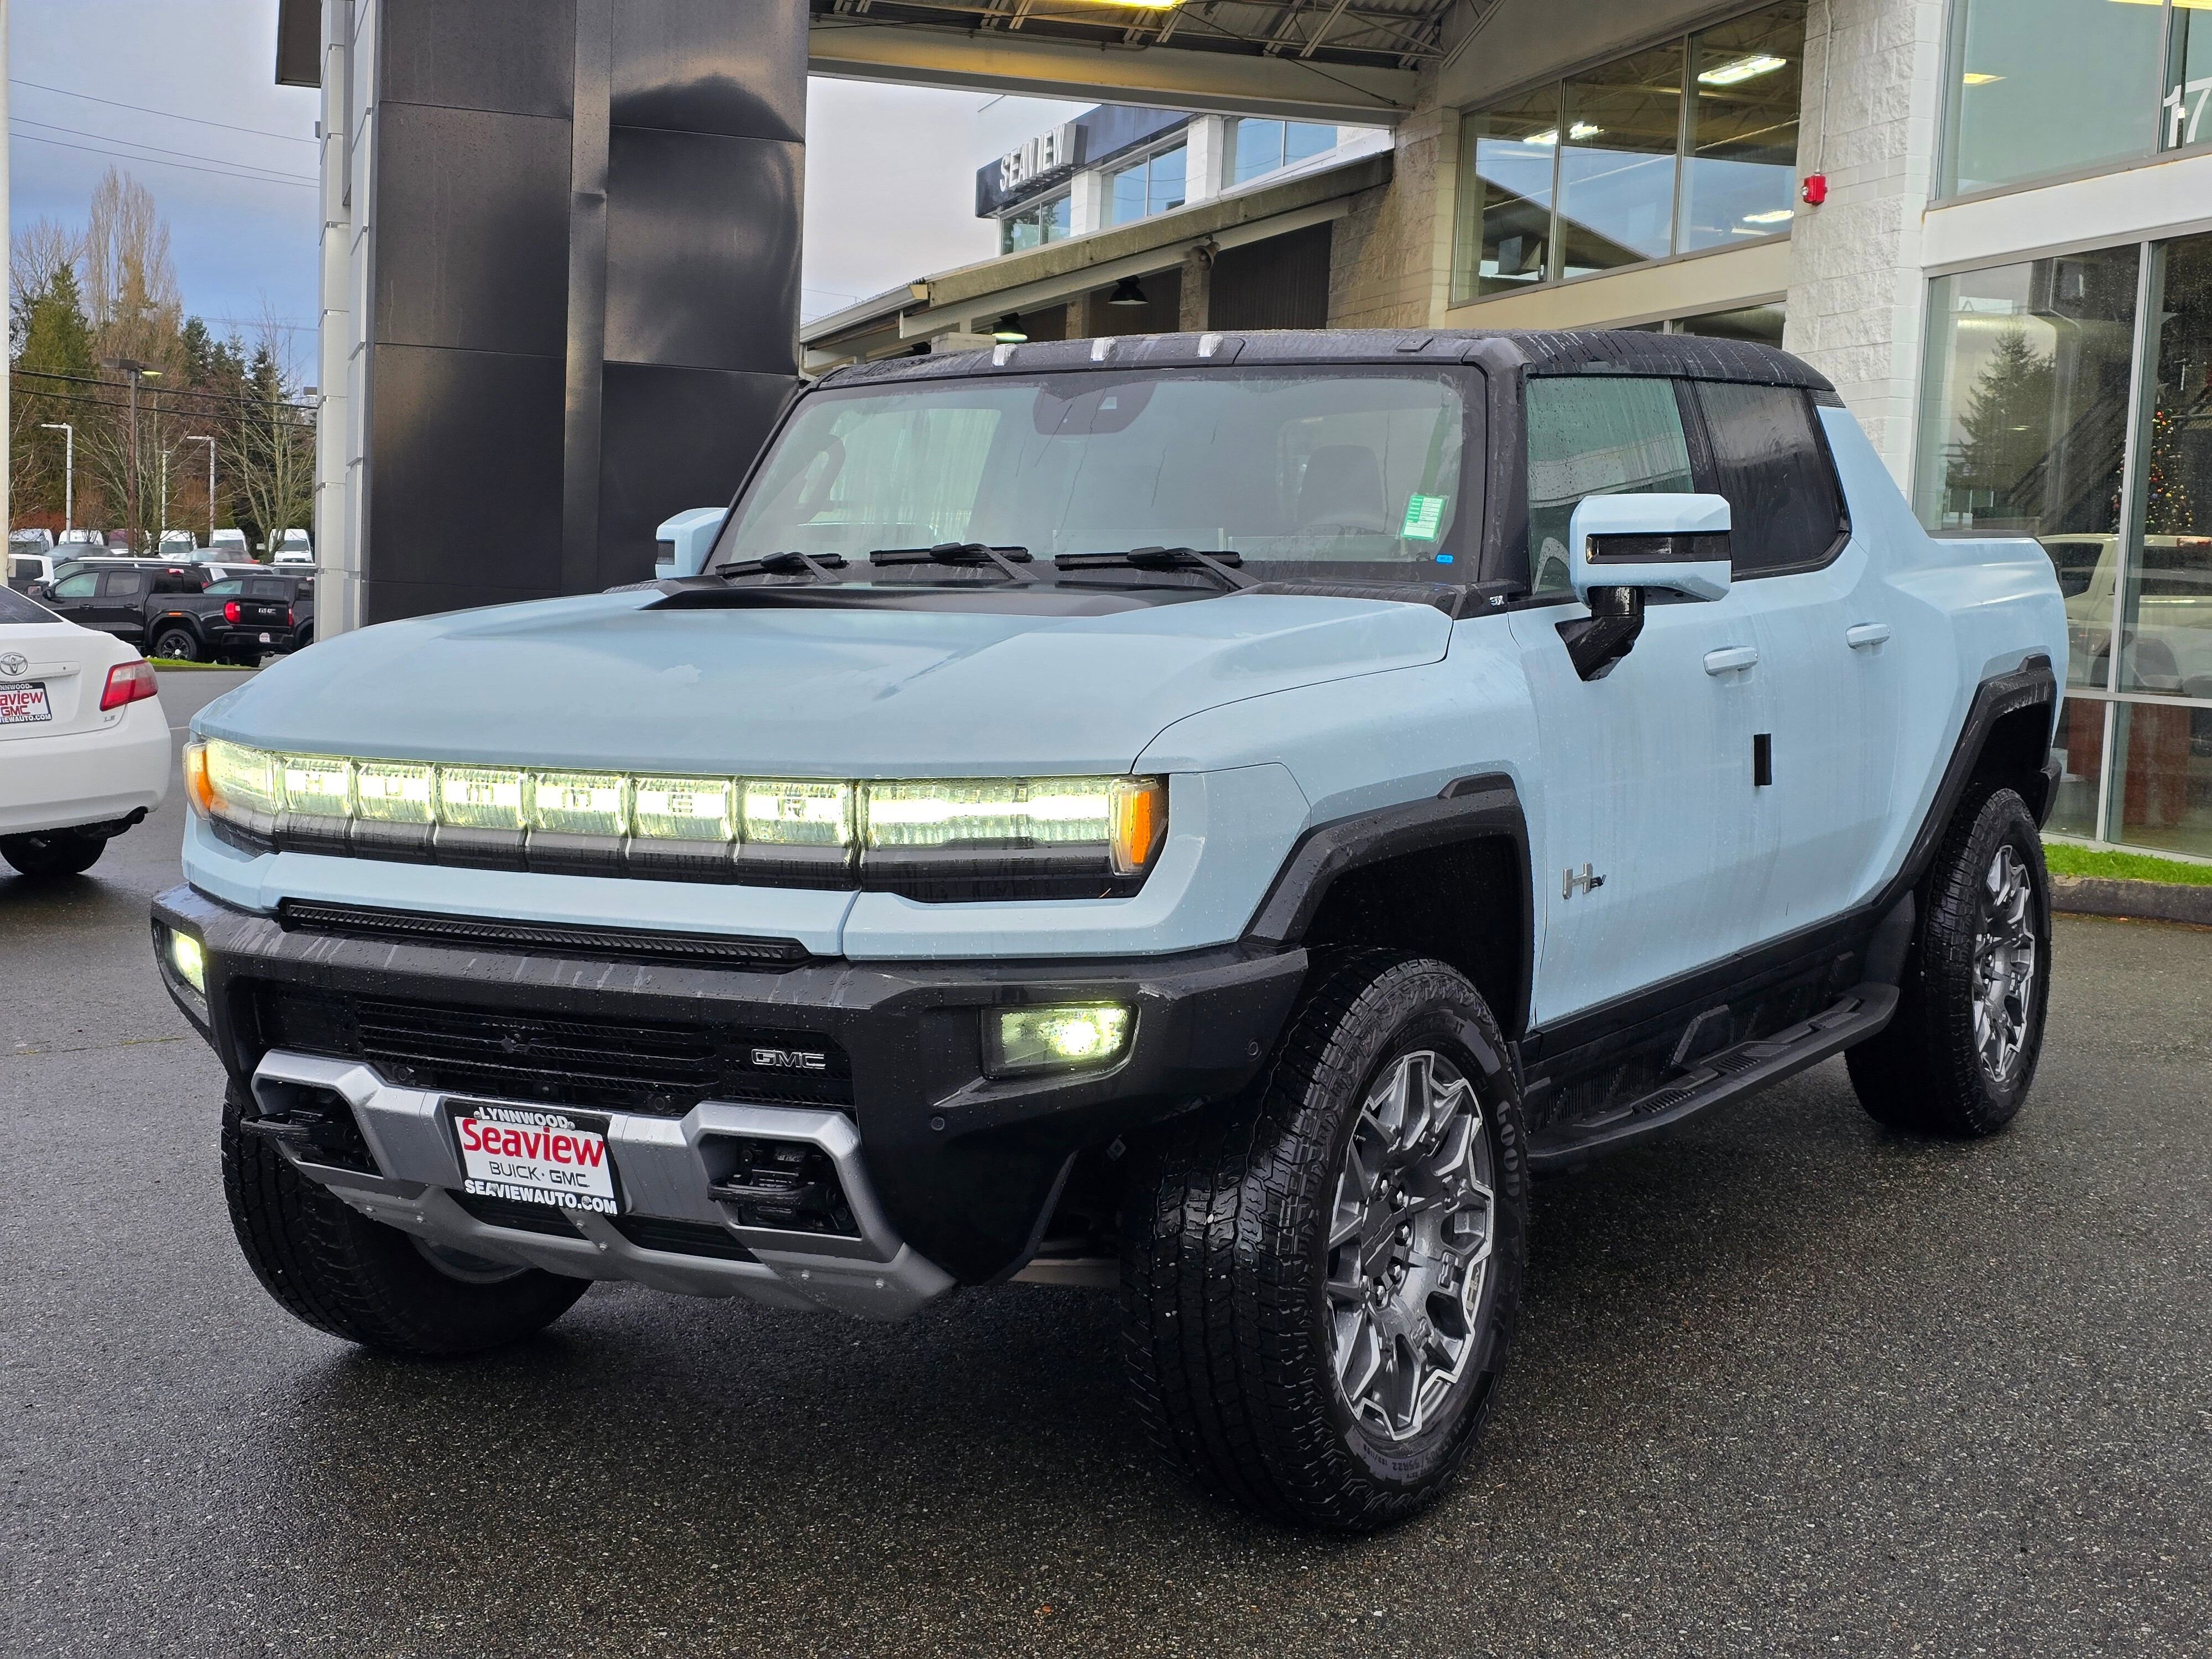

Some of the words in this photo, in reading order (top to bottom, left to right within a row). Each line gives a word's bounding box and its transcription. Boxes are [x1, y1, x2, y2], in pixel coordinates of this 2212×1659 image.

[999, 123, 1076, 192] SEAVIEW
[1, 705, 30, 716] GMC
[751, 1048, 826, 1070] GMC
[478, 1107, 569, 1129] LYNNWOOD
[462, 1118, 605, 1168] Seaview
[489, 1161, 541, 1181] BUICK
[549, 1169, 591, 1188] GMC
[464, 1180, 618, 1215] SEAVIEWAUTO.COM
